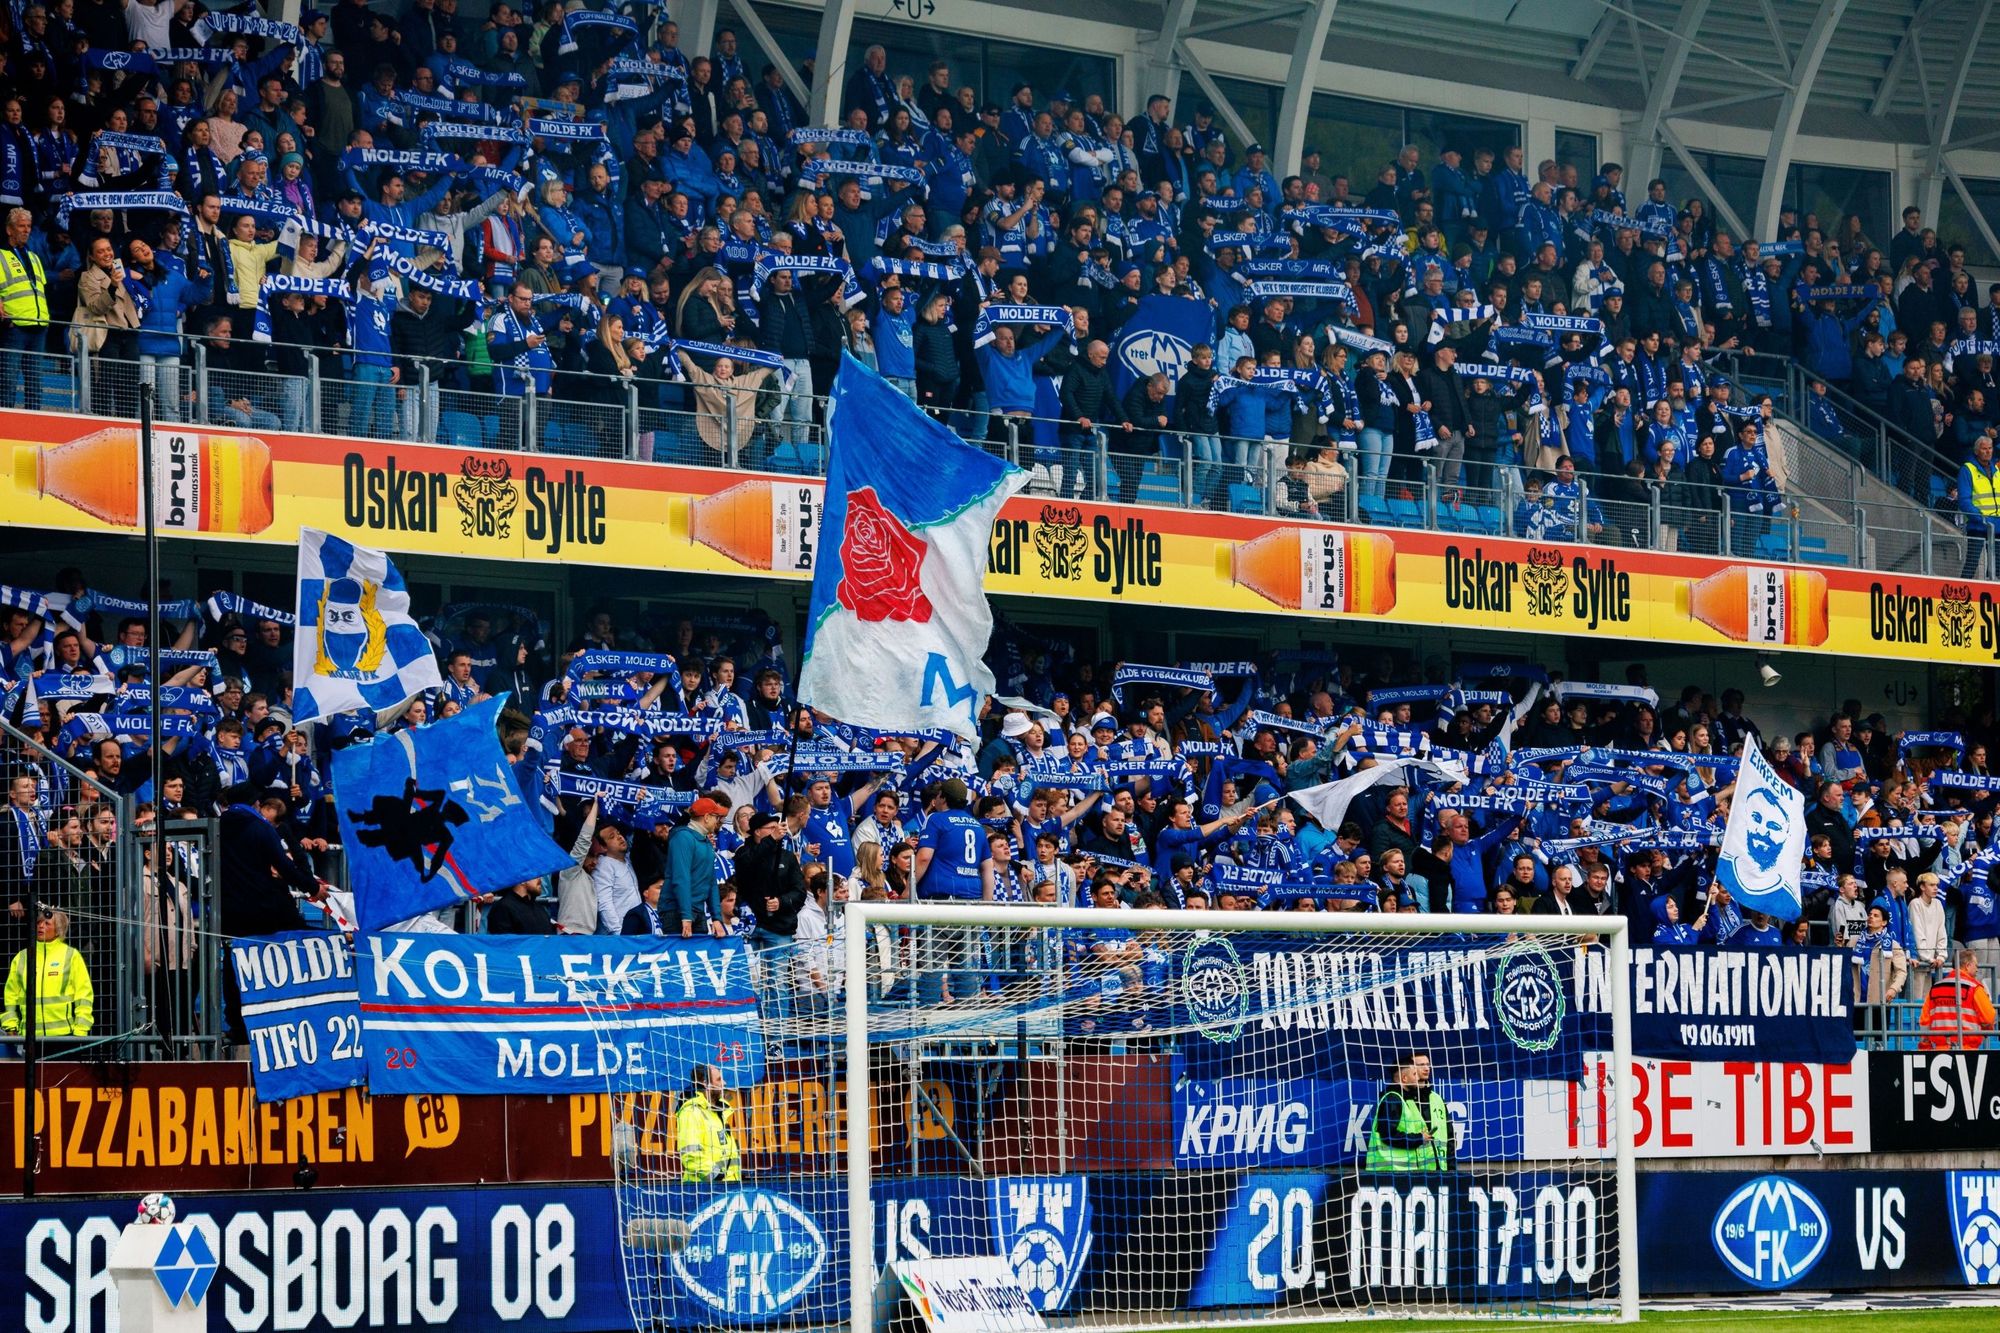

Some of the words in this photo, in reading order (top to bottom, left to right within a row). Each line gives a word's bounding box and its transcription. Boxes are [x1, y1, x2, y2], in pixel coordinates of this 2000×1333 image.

[579, 12, 614, 22] CUPFINALEN
[152, 47, 205, 62] OLDE
[210, 48, 235, 63] FK
[619, 61, 661, 71] MOLDE
[664, 64, 679, 75] FK
[457, 101, 480, 115] FK
[436, 123, 485, 135] MOLDE
[491, 127, 509, 138] FK
[540, 122, 577, 136] MOLDE
[579, 125, 592, 136] FK
[796, 129, 840, 140] MOLDE
[842, 131, 857, 141] FK
[6, 143, 17, 175] MFK
[362, 148, 420, 164] MOLDE
[425, 152, 449, 167] FK
[484, 167, 512, 184] MFK
[823, 161, 879, 173] MOLDE
[881, 165, 900, 177] FK
[109, 193, 122, 205] DEN
[156, 193, 186, 210] KLUBBEN
[365, 221, 430, 245] MOLDE
[1213, 233, 1247, 244] ELSKER
[382, 244, 445, 293] MOLDE
[448, 280, 474, 298] FK
[775, 256, 818, 267] MOLDE
[821, 256, 838, 268] FK
[1249, 261, 1283, 271] ELSKER
[1312, 263, 1330, 274] MFK
[262, 273, 323, 293] MOLDE
[327, 278, 350, 298] FK
[1279, 283, 1290, 293] DEN
[1315, 284, 1340, 295] KLUBBEN
[1810, 287, 1848, 297] MOLDE
[1850, 286, 1864, 296] FK
[999, 307, 1039, 320] MOLDE
[1041, 308, 1058, 321] FK
[1536, 316, 1572, 328] MOLDE
[1574, 319, 1588, 329] FK
[688, 340, 736, 354] CUPFINALEN
[1251, 367, 1290, 379] OLDE
[1293, 370, 1313, 382] FK
[1454, 362, 1507, 378] MOLDE
[1510, 366, 1532, 382] FK
[164, 436, 186, 527] brus
[188, 452, 198, 513] ananassmak
[343, 452, 447, 533] Oskar
[525, 466, 606, 554] Sylte
[794, 488, 813, 570] brus
[986, 516, 1029, 576] kar
[1093, 515, 1163, 595] Sylte
[1319, 533, 1335, 609] brus
[1336, 547, 1344, 598] ananassmak
[1445, 545, 1519, 616] Oskar
[1573, 557, 1632, 630] Sylte
[98, 595, 182, 613] TORNEKRTTET
[1764, 571, 1777, 641] brus
[1871, 582, 1934, 644] Oskar
[251, 602, 296, 625] MOLD
[585, 655, 620, 665] ELSKER
[625, 656, 657, 667] MOLDE
[660, 658, 674, 669] BY
[1190, 662, 1235, 674] MOLDE
[1237, 661, 1256, 674] FK
[327, 670, 360, 681] MOLDE
[1115, 668, 1140, 681] OLDE
[1140, 669, 1211, 686] FOTBALLKLUBB
[576, 684, 610, 697] MOLDE
[611, 683, 625, 697] FK
[1372, 691, 1401, 702] ELSKER
[1402, 689, 1429, 697] MOLDE
[1586, 683, 1607, 691] MOLDE
[86, 714, 102, 730] 1911
[650, 718, 702, 732] MOLDE
[705, 717, 721, 733] FK
[1181, 741, 1219, 752] MOLDE
[1221, 742, 1235, 757] FK
[793, 755, 889, 764] MOLDE
[1095, 761, 1149, 772] ELSKER
[1150, 761, 1177, 771] MFK
[1694, 756, 1728, 765] MOLDE
[1031, 771, 1095, 785] TORNEKRATTET
[1942, 772, 1986, 788] MOLDE
[575, 779, 624, 798] MOLDE
[1565, 787, 1578, 797] FK
[1434, 793, 1490, 809] MOLDE
[1494, 798, 1515, 812] FK
[1860, 826, 1914, 839] MOLDE
[1916, 824, 1937, 837] FK
[964, 828, 976, 865] 8
[1274, 887, 1312, 896] ELSKER
[1315, 887, 1347, 896] MOLDE
[233, 934, 351, 993] MOLDE
[368, 935, 737, 1003] KOLLEKTIV
[1505, 963, 1548, 983] TORNEKRATTET
[1253, 948, 1490, 1031] TORNEKRATTET
[1508, 1012, 1554, 1032] SUPPORTER
[250, 1019, 318, 1073] TIFO
[328, 1014, 364, 1062] 22
[385, 1047, 418, 1070] 20
[496, 1038, 648, 1079] MOLDE
[1903, 1053, 1989, 1122] FSV
[1724, 1061, 1854, 1148] TIBE
[14, 1086, 374, 1169] PIZZABAKEREN
[570, 1081, 879, 1158] PIZZAKERE
[1180, 1101, 1309, 1155] KPMG
[1344, 1101, 1467, 1154] KG
[1724, 1222, 1746, 1239] 19/6
[1798, 1221, 1819, 1237] 1911
[1855, 1186, 1906, 1270] VS
[1248, 1186, 1326, 1290] 20.
[1350, 1185, 1450, 1288] MAI
[1468, 1186, 1597, 1286] 17:00
[25, 1206, 459, 1333] SASBORG
[490, 1203, 576, 1321] 08
[928, 1279, 984, 1313] Norsk
[968, 1276, 1036, 1319] Tipping
